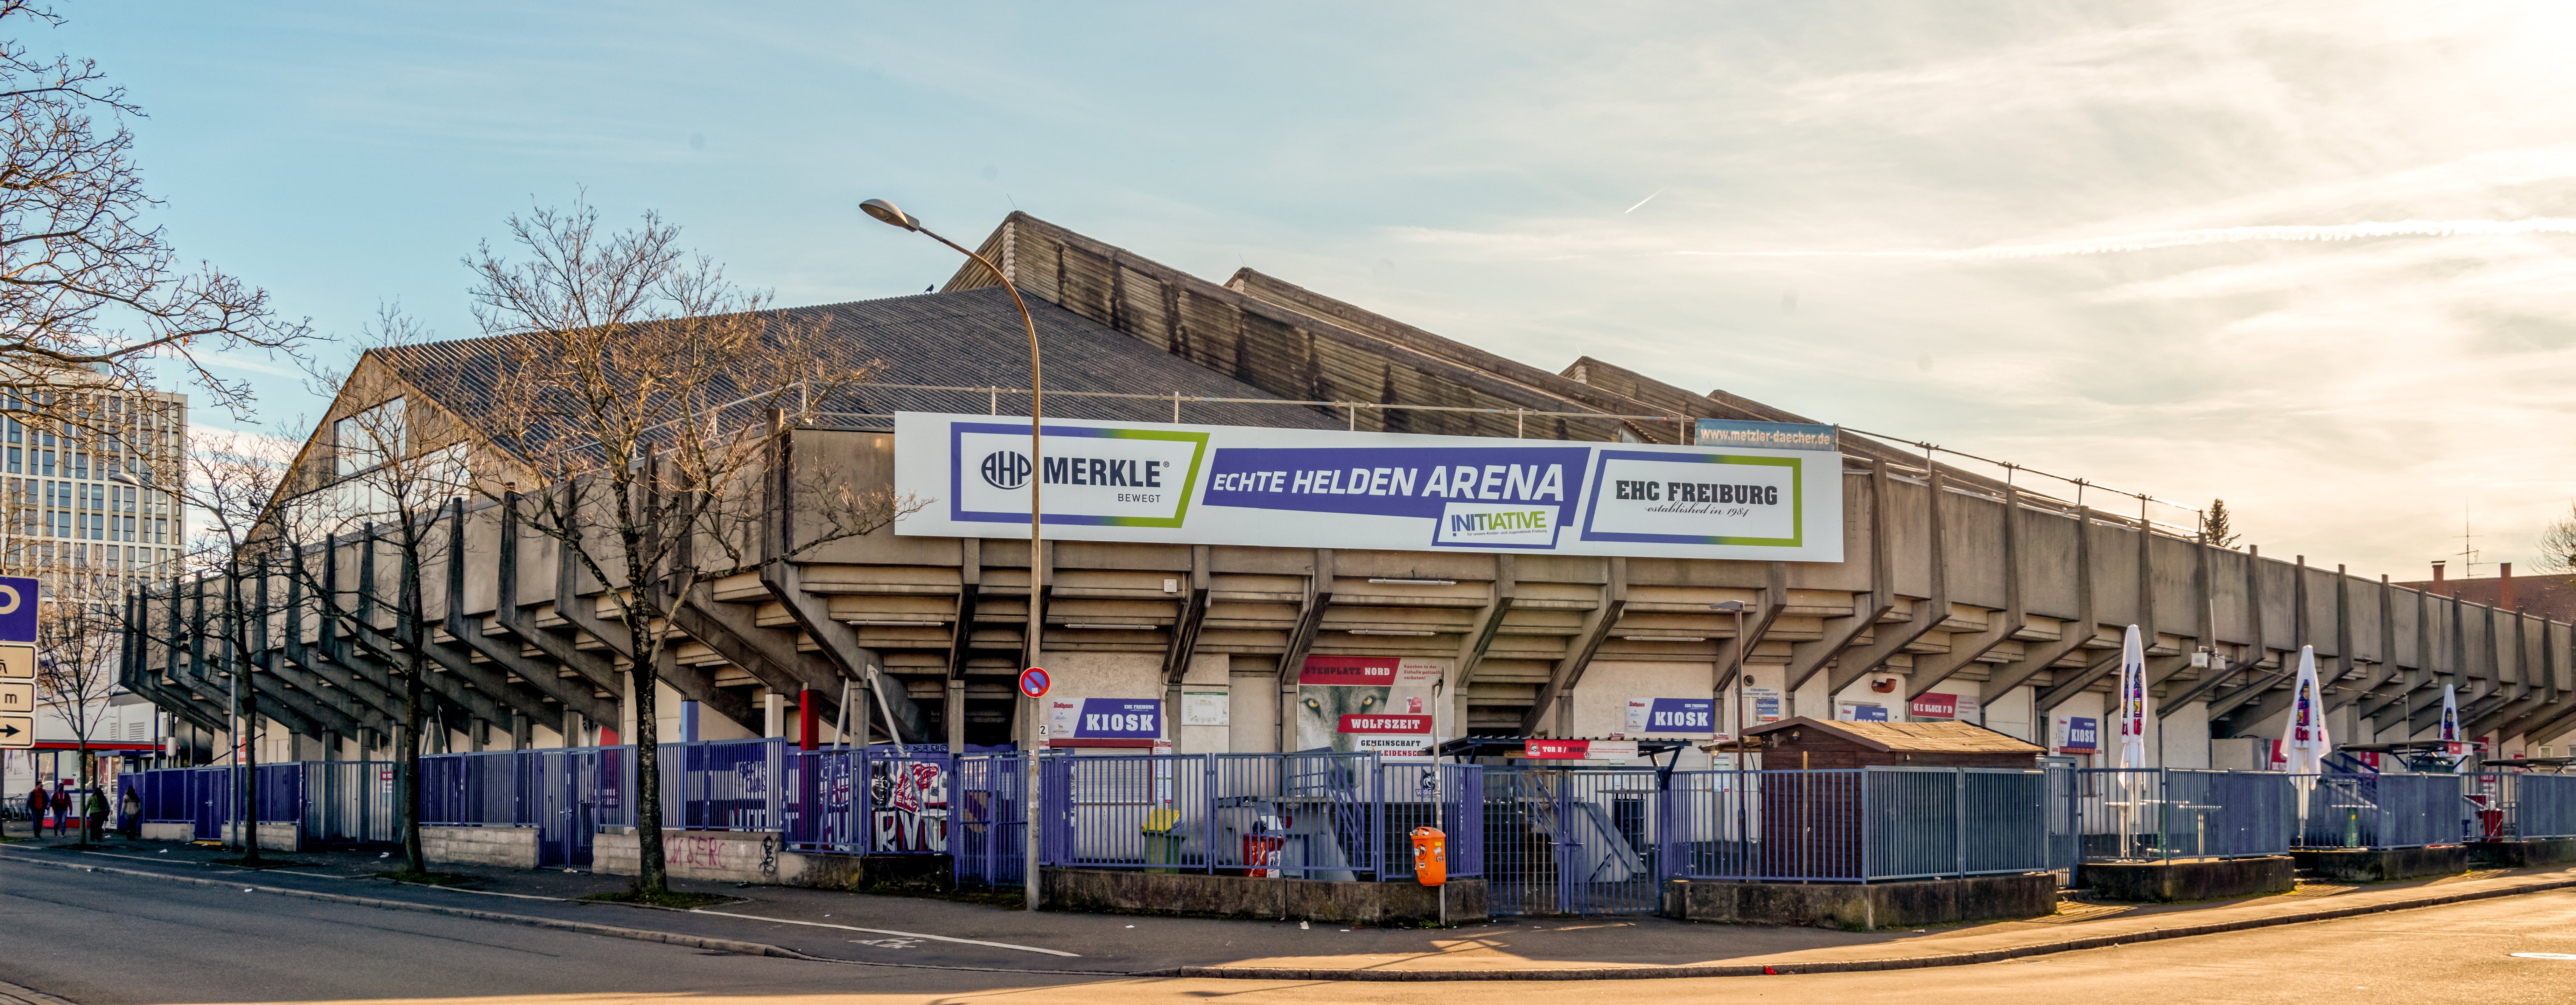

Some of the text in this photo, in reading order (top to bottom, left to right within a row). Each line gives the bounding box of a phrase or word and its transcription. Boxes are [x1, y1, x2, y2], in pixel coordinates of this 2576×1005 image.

[1701, 429, 1830, 445] www.metzler-daecher.de
[981, 451, 1032, 489] AHP
[1213, 464, 1563, 501] ECHTE HELDEN ARENA
[1118, 494, 1161, 502] BEWEGT
[1616, 480, 1777, 505] EHC FREIBURG
[1645, 500, 1750, 517] established in 1984
[1304, 667, 1390, 675] STEHPLATZ NORD
[5, 693, 17, 704] m
[1925, 704, 1941, 713] BLOCK
[1086, 714, 1154, 731] KIOSK
[1351, 719, 1420, 729] WOLFSZEIT
[1655, 712, 1708, 726] KIOSK
[1040, 726, 1045, 734] 2
[2071, 729, 2095, 742] KIOSK
[687, 836, 726, 869] SERC
